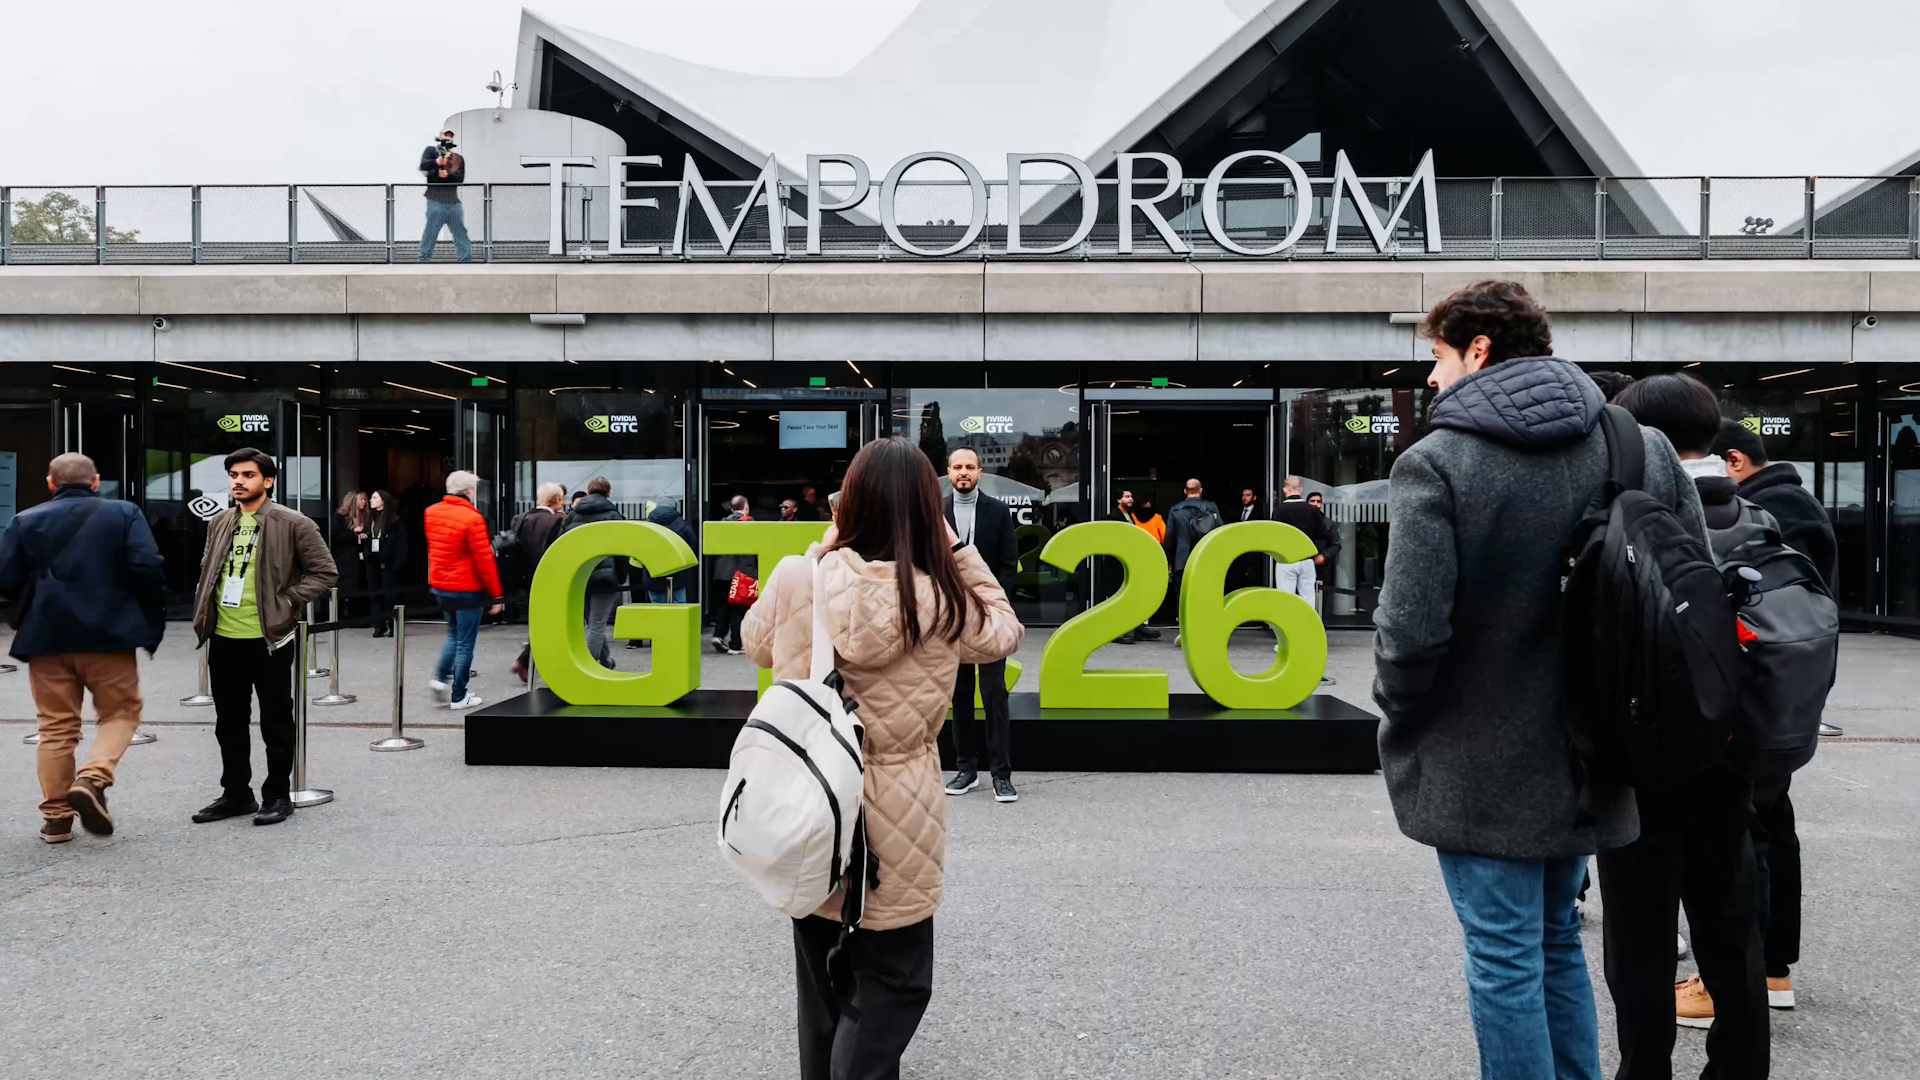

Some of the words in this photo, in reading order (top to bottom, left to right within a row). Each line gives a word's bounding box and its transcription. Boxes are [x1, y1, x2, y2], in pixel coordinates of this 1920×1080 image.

[520, 147, 1443, 257] TEMPODROM
[242, 421, 269, 432] GTC
[610, 422, 638, 433] GTC
[986, 423, 1013, 433] GTC
[1371, 423, 1399, 433] GTC
[1762, 424, 1791, 435] GTC
